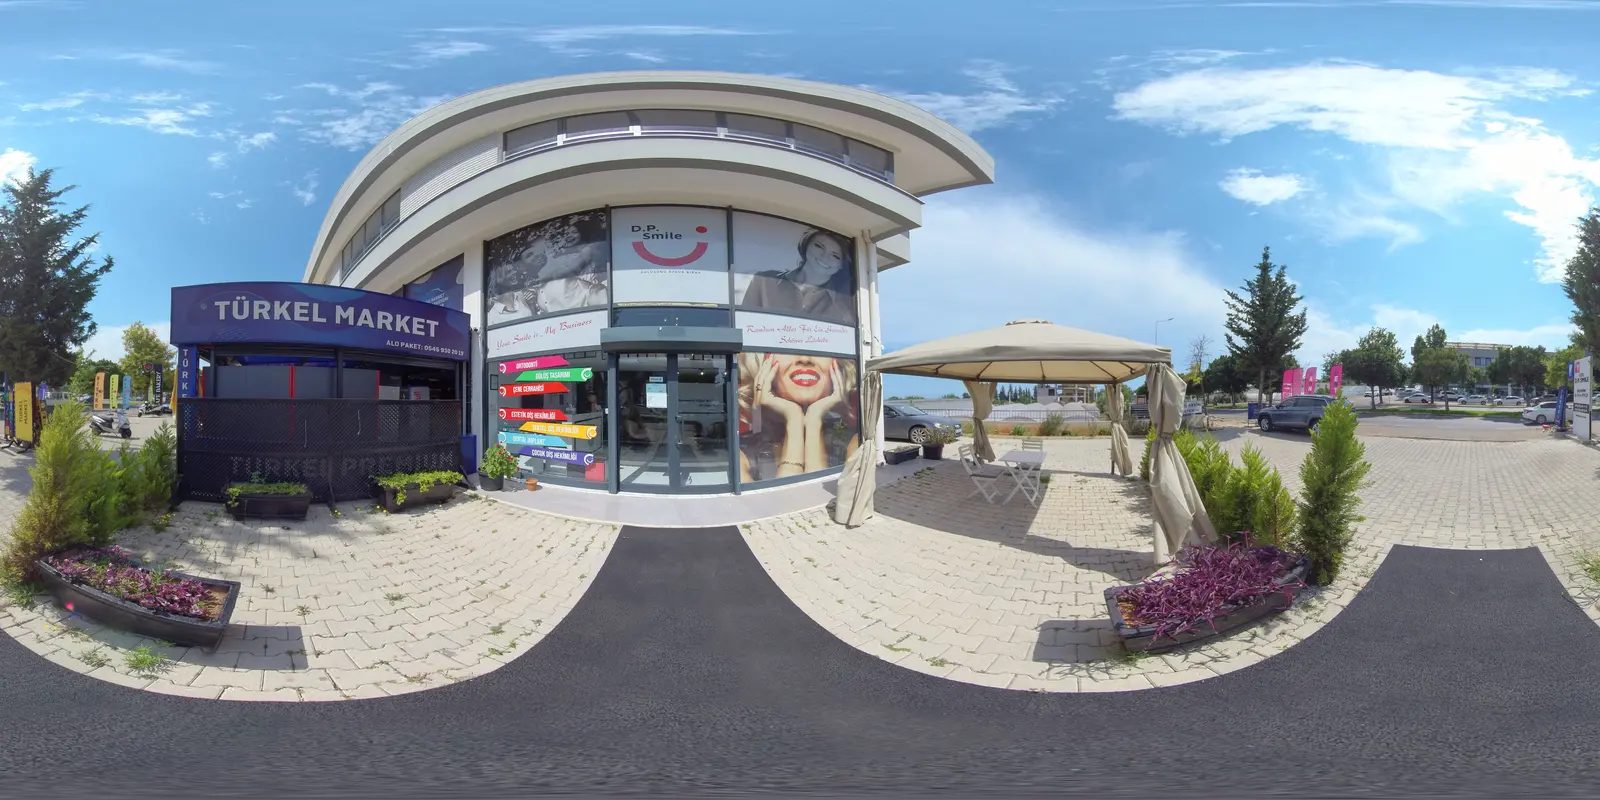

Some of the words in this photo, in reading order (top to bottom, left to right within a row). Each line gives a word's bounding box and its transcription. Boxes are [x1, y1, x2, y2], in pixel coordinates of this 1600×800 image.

[631, 225, 659, 233] D.P.
[642, 231, 683, 240] Smile
[214, 295, 327, 323] TÜRKEL
[335, 305, 439, 338] MARKET
[496, 340, 511, 350] Your
[512, 333, 531, 344] Smile
[540, 326, 556, 337] My
[559, 319, 592, 331] Business
[386, 340, 400, 348] ALO
[400, 342, 423, 350] PAKET:
[512, 386, 523, 394] ÇENE
[526, 411, 534, 419] DİŞ
[531, 449, 546, 457] ÇOCUK
[546, 450, 554, 458] DİŞ
